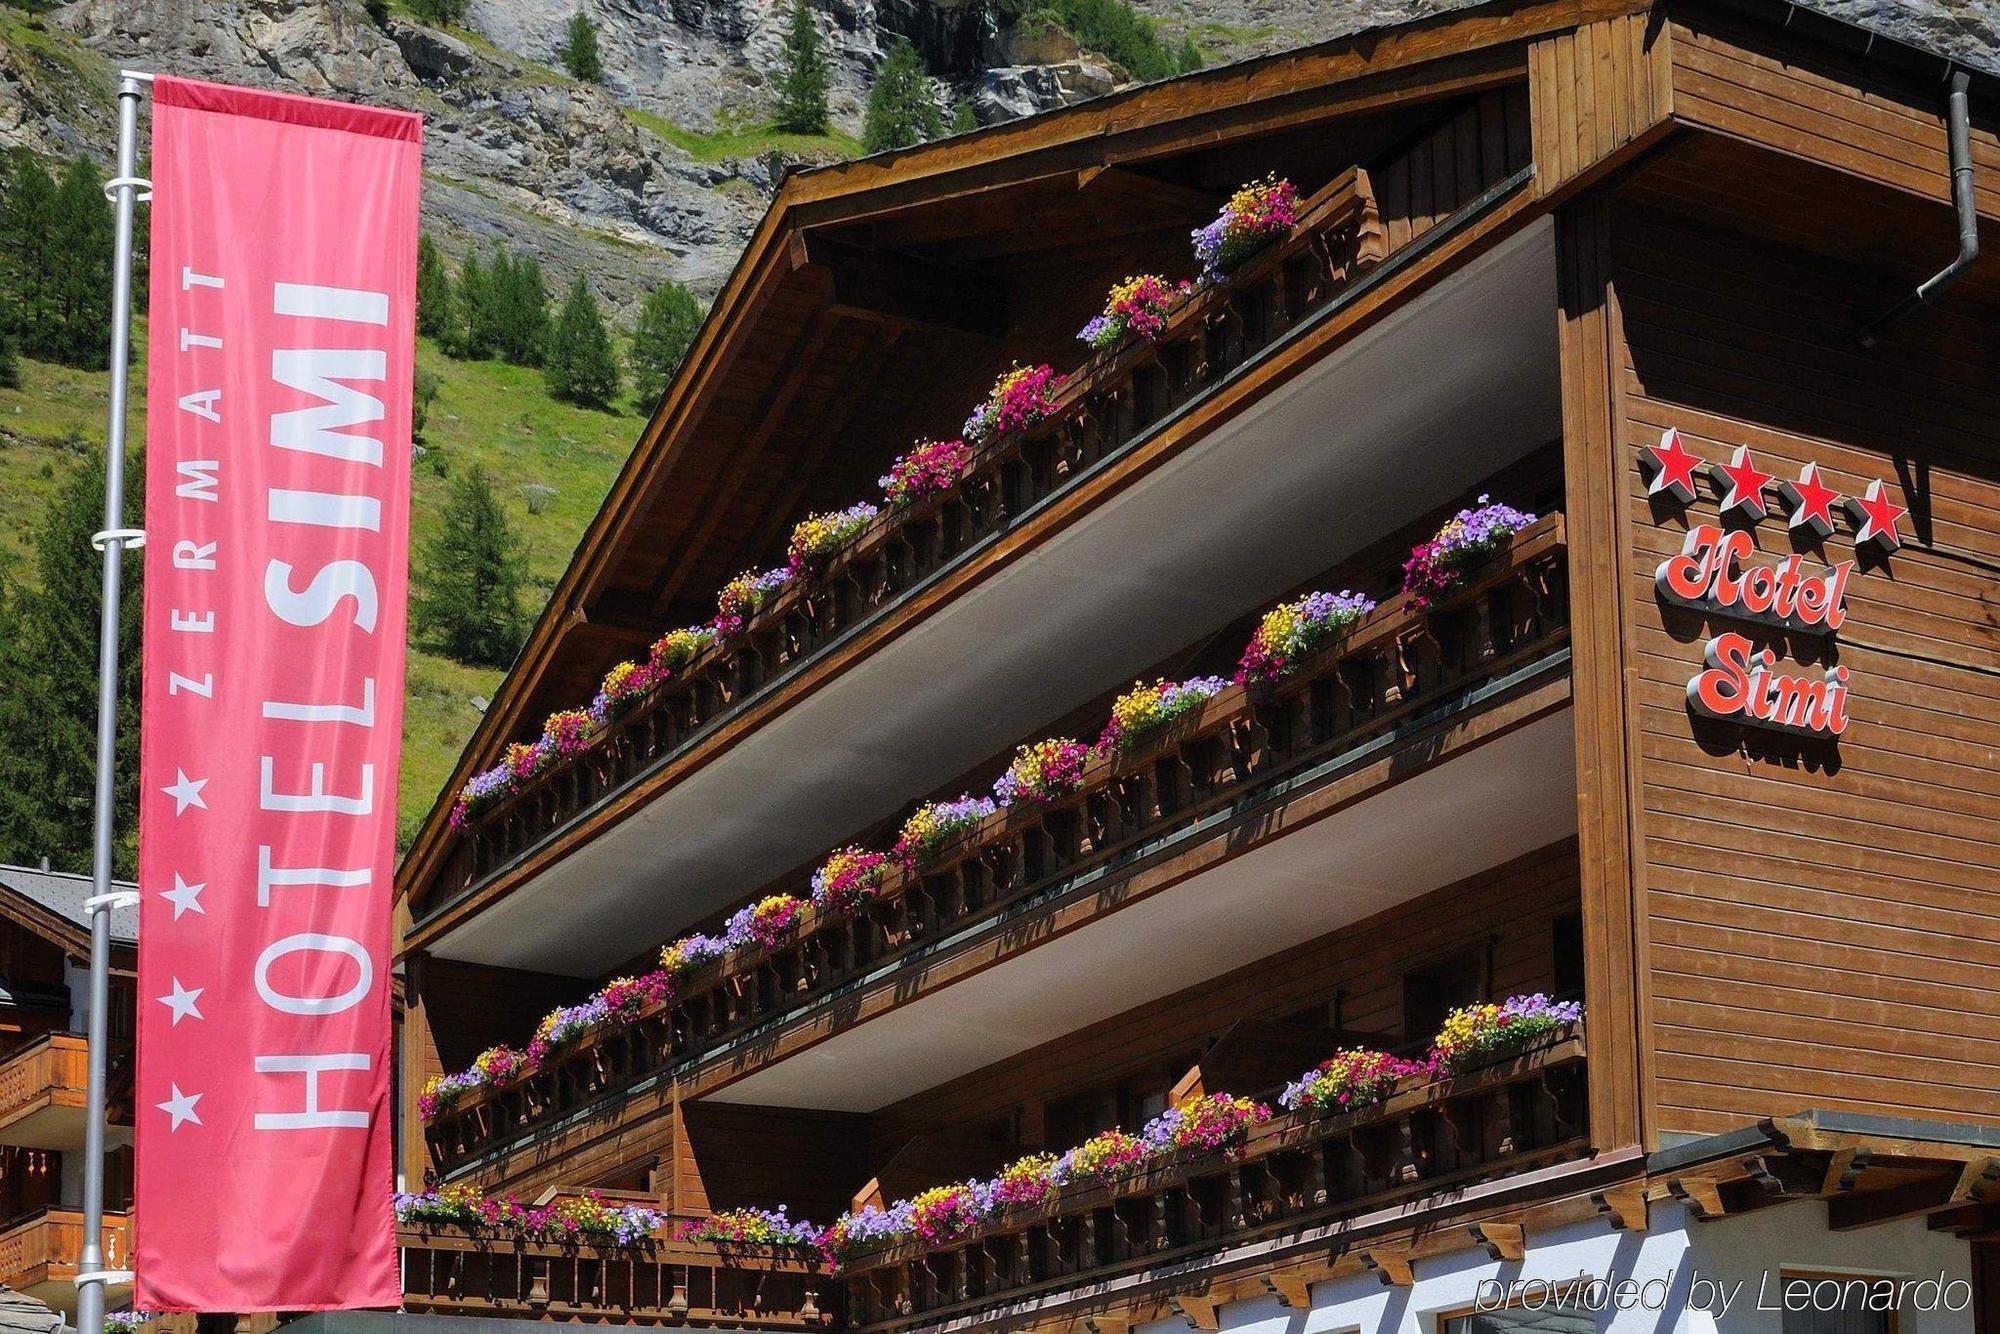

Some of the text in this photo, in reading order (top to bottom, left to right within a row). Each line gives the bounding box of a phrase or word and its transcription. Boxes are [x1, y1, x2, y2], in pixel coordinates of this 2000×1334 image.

[169, 266, 225, 699] ZERMATT
[1656, 525, 1854, 630] Hotel
[1688, 632, 1850, 735] Simi
